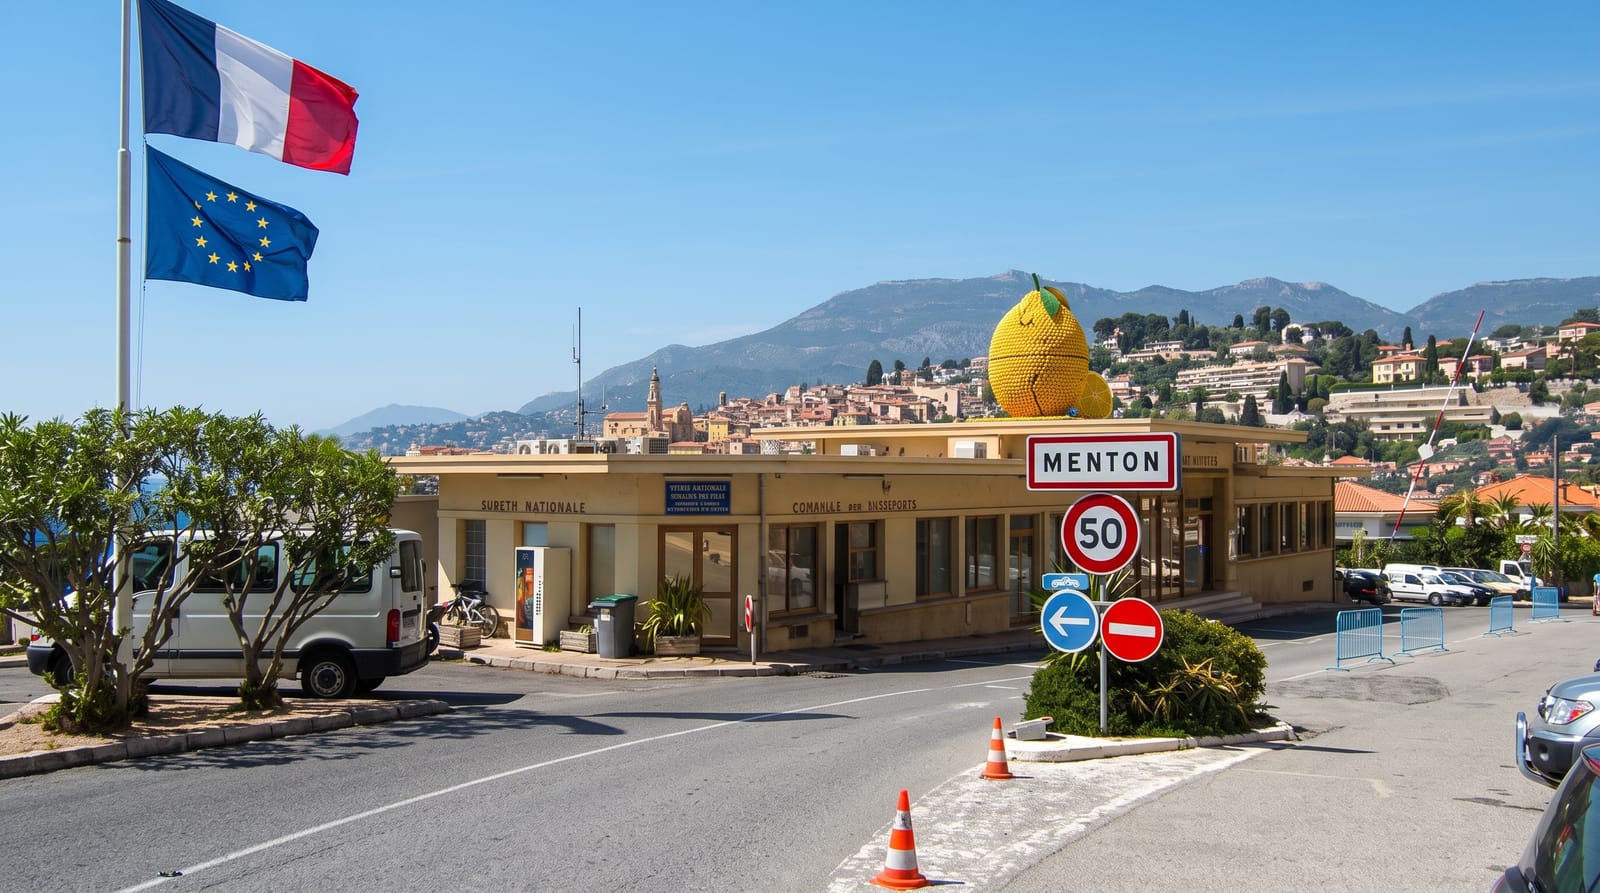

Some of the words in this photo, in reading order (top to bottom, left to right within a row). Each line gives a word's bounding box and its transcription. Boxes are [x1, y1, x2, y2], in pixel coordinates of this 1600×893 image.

[1043, 451, 1159, 473] MENTON
[481, 500, 518, 512] SURETH
[525, 501, 586, 513] NATIONALE
[1080, 517, 1123, 550] 50
